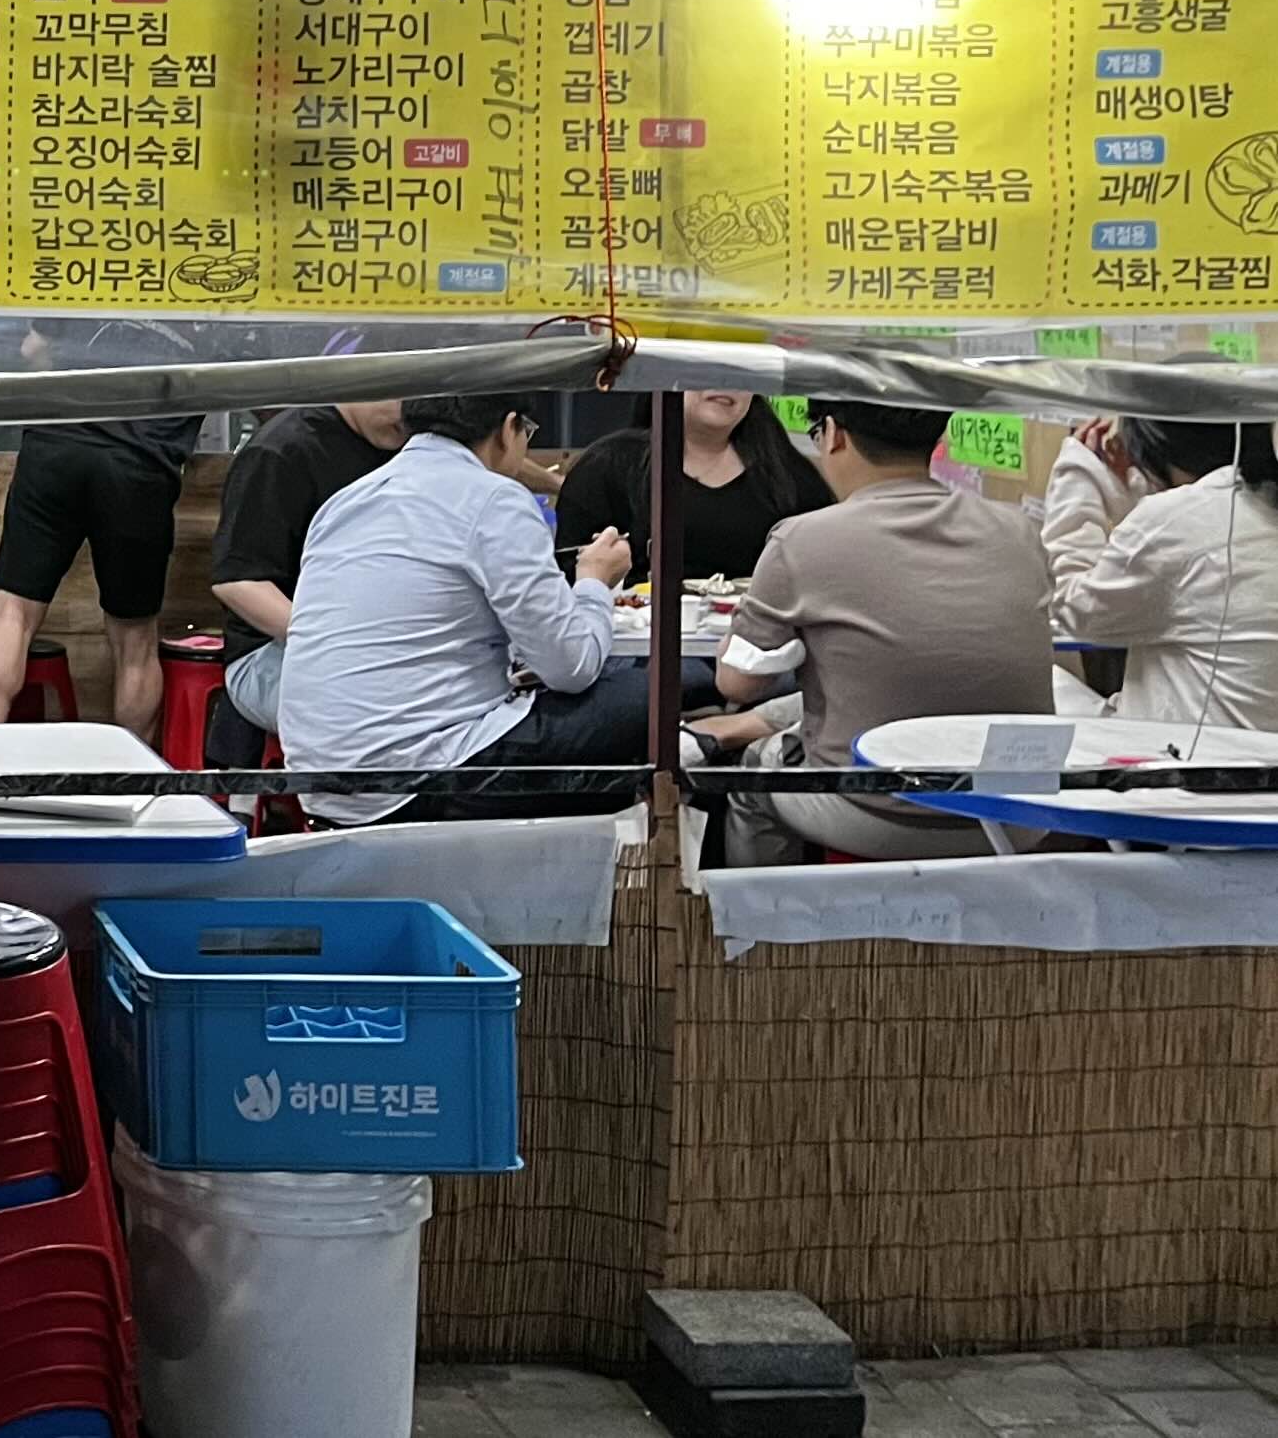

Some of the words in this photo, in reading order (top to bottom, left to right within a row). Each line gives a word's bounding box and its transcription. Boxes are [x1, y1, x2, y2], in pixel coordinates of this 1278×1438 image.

[32, 12, 169, 47] 꼬막무침
[294, 11, 431, 47] 서대구이
[564, 21, 665, 57] 껍데기
[823, 22, 998, 59] 쭈꾸미볶음
[31, 53, 134, 88] 바지락
[148, 54, 217, 89] 술찜
[293, 53, 465, 88] 노가리구이
[1105, 52, 1156, 76] 계절용
[561, 69, 632, 105] 곱창
[822, 71, 962, 108] 낙지볶음
[1095, 84, 1234, 120] 매생이탕
[31, 94, 202, 129] 참소라숙회
[292, 94, 429, 129] 삼치구이
[29, 136, 201, 170] 오징어숙회
[562, 117, 631, 153] 닭발
[822, 119, 960, 156] 순대볶음
[1104, 138, 1154, 162] 계절용
[292, 136, 393, 171] 고등어
[413, 142, 462, 164] 고갈비
[29, 177, 165, 211] 문어숙회
[292, 176, 463, 211] 메추리구이
[560, 167, 662, 202] 오돌뼈
[822, 169, 1033, 204] 고기숙주볶음
[1098, 169, 1192, 207] 과메기
[30, 217, 237, 253] 갑오징어숙회
[292, 217, 428, 253] 스팸구이
[560, 215, 662, 250] 꼼장어
[825, 217, 999, 253] 매운닭갈비
[1099, 224, 1148, 247] 계절용
[29, 257, 166, 293] 홍어무침
[292, 258, 428, 294] 전어구이
[563, 262, 701, 299] 계란말이
[826, 265, 996, 300] 카레주물럭
[288, 1081, 440, 1118] 하이트진로
